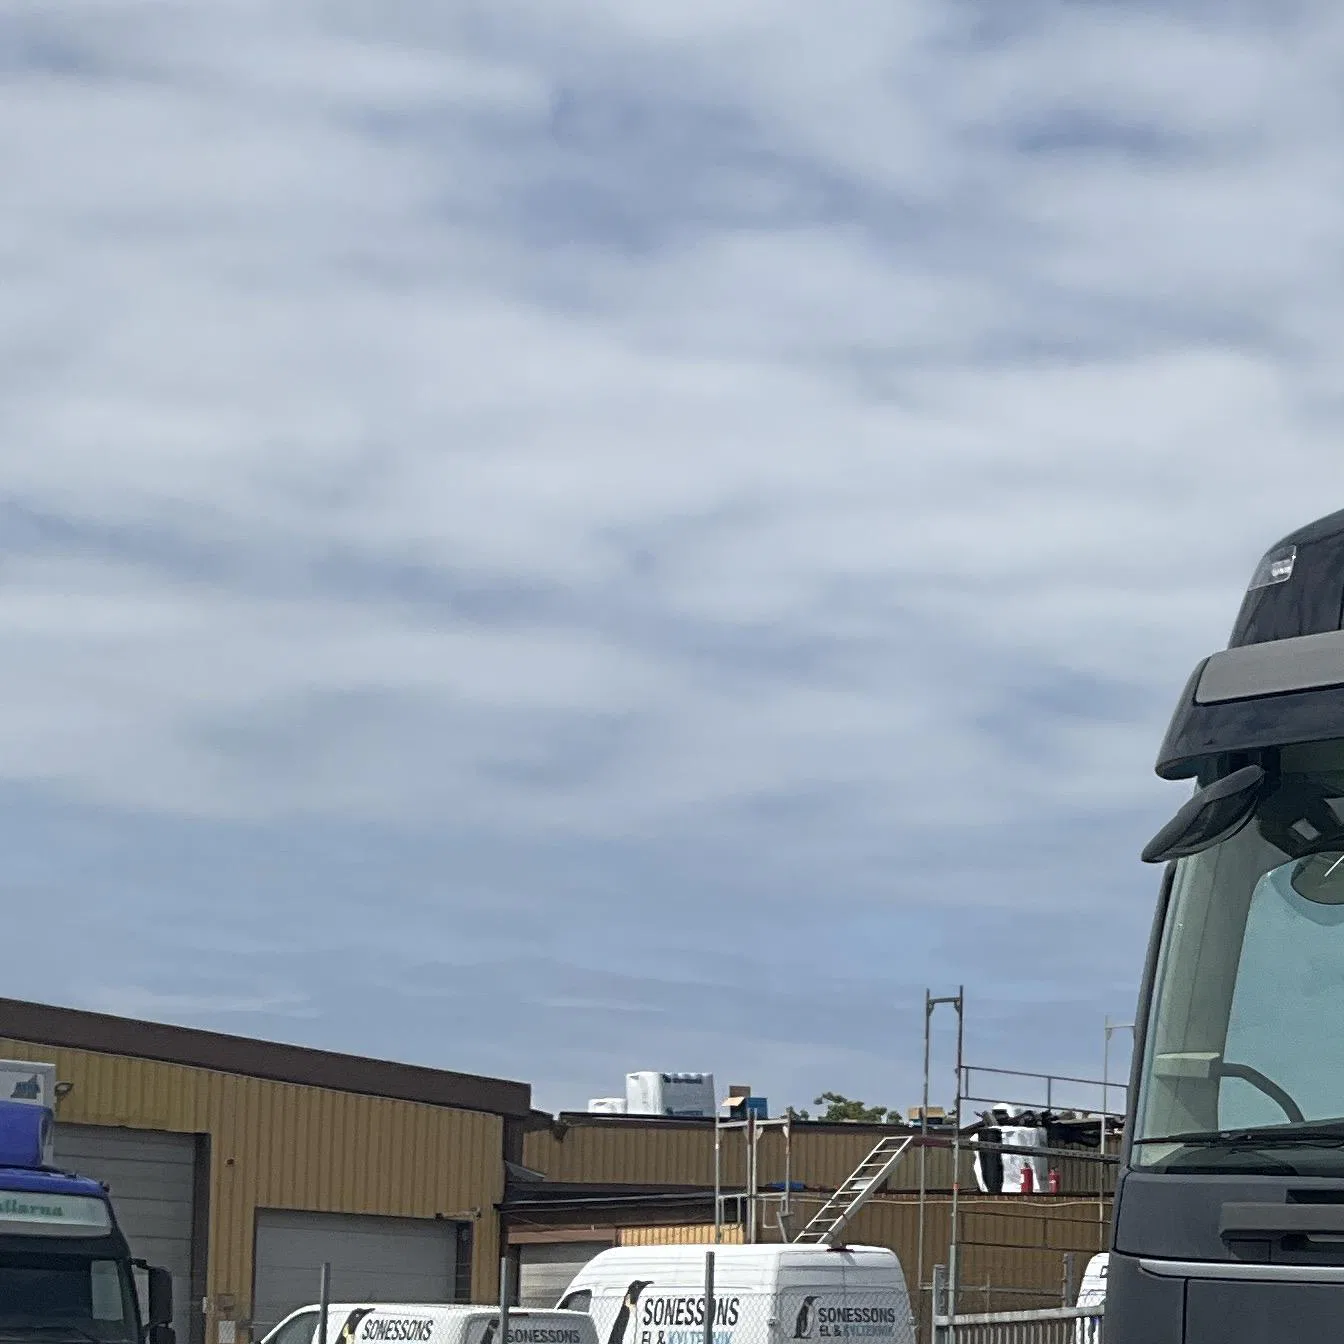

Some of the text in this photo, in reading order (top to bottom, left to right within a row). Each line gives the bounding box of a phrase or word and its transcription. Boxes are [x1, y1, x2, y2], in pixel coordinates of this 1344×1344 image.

[643, 1298, 740, 1326] SONESSNS
[818, 1308, 895, 1323] SONESSONS
[362, 1319, 433, 1341] SONESSONS
[507, 1329, 581, 1344] SONESSONS
